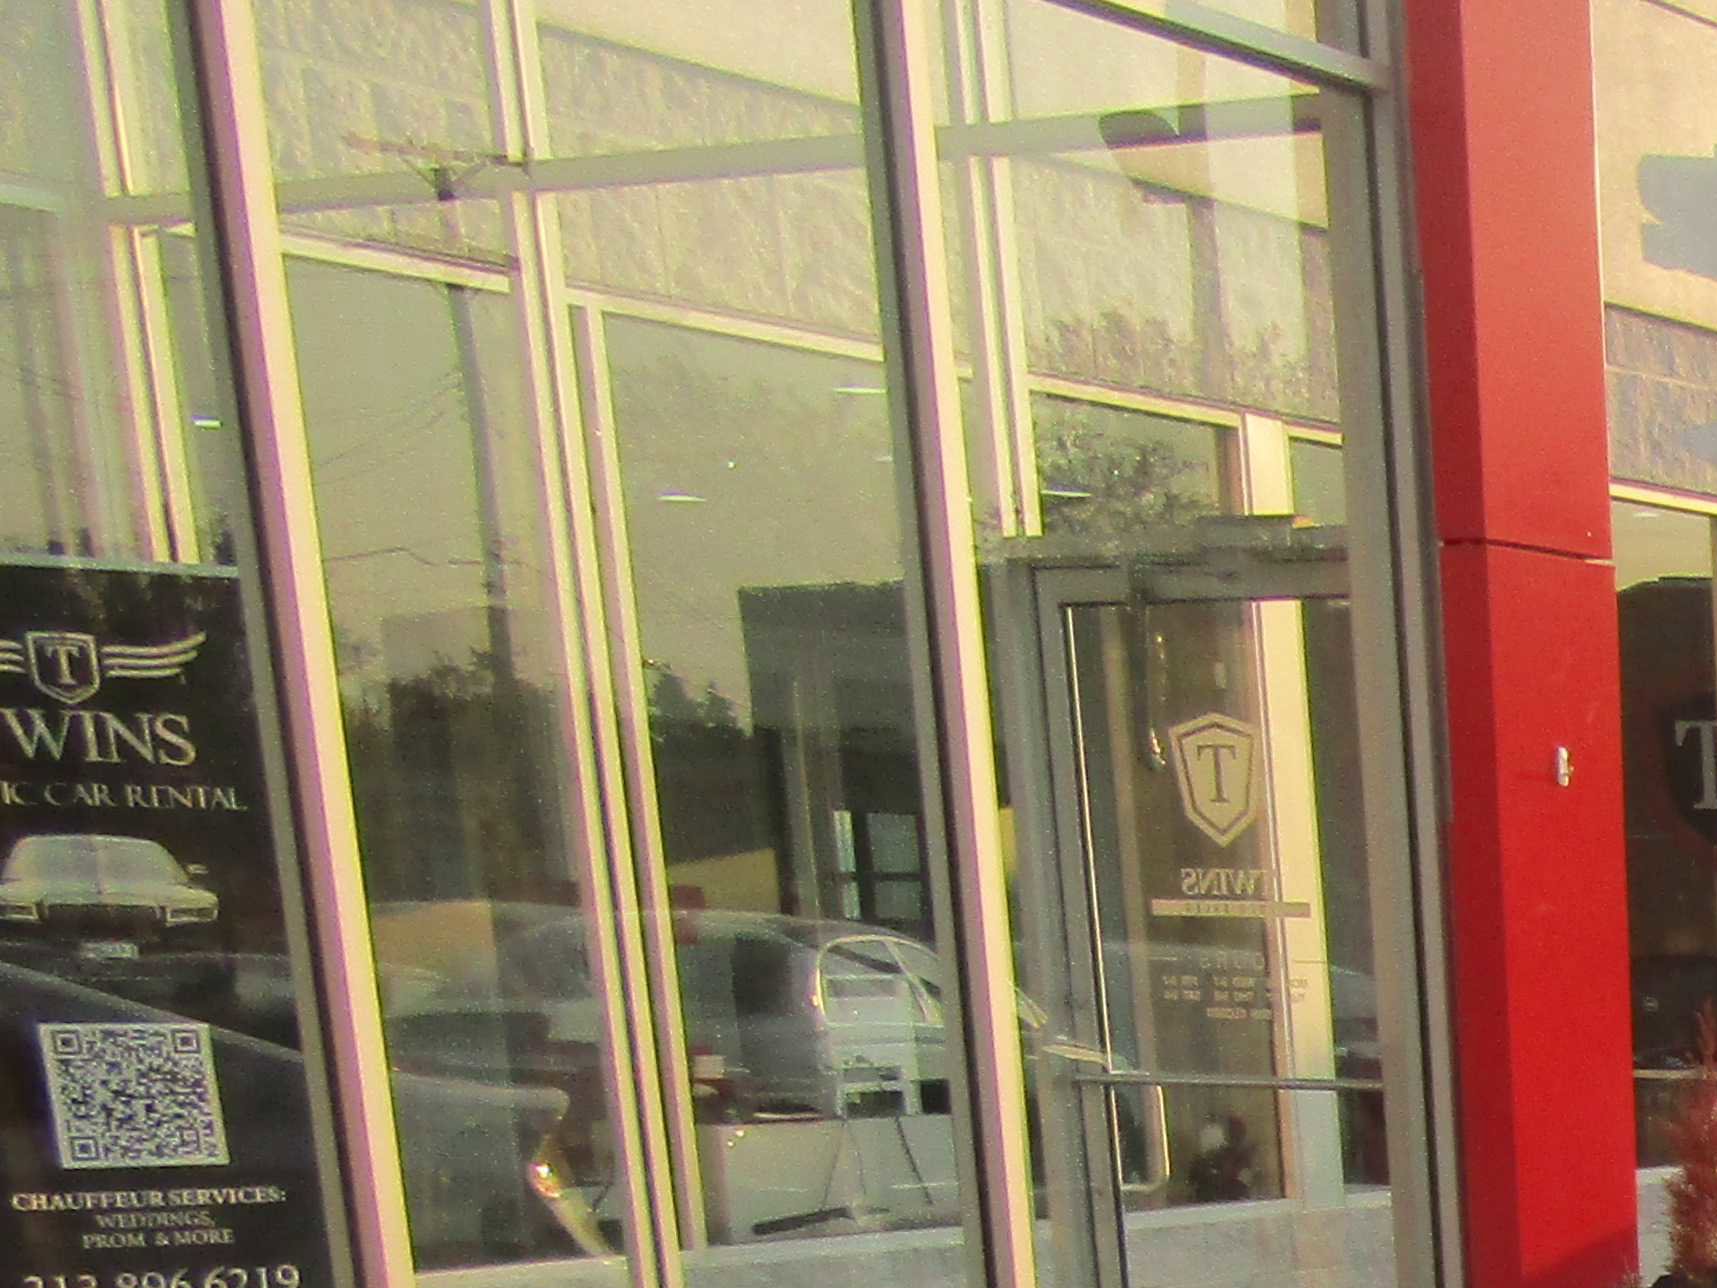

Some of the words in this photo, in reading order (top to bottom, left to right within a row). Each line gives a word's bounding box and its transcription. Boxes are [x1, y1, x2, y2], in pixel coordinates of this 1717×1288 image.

[46, 645, 79, 685] T
[44, 782, 117, 807] CAR
[125, 784, 248, 811] RENTAL
[11, 1189, 165, 1212] CHAUFFEUR
[168, 1185, 287, 1206] SERVICES:
[96, 1210, 216, 1229] WEDDINGS,
[82, 1231, 146, 1249] PROM
[154, 1231, 169, 1246] &
[172, 1228, 235, 1246] MORE
